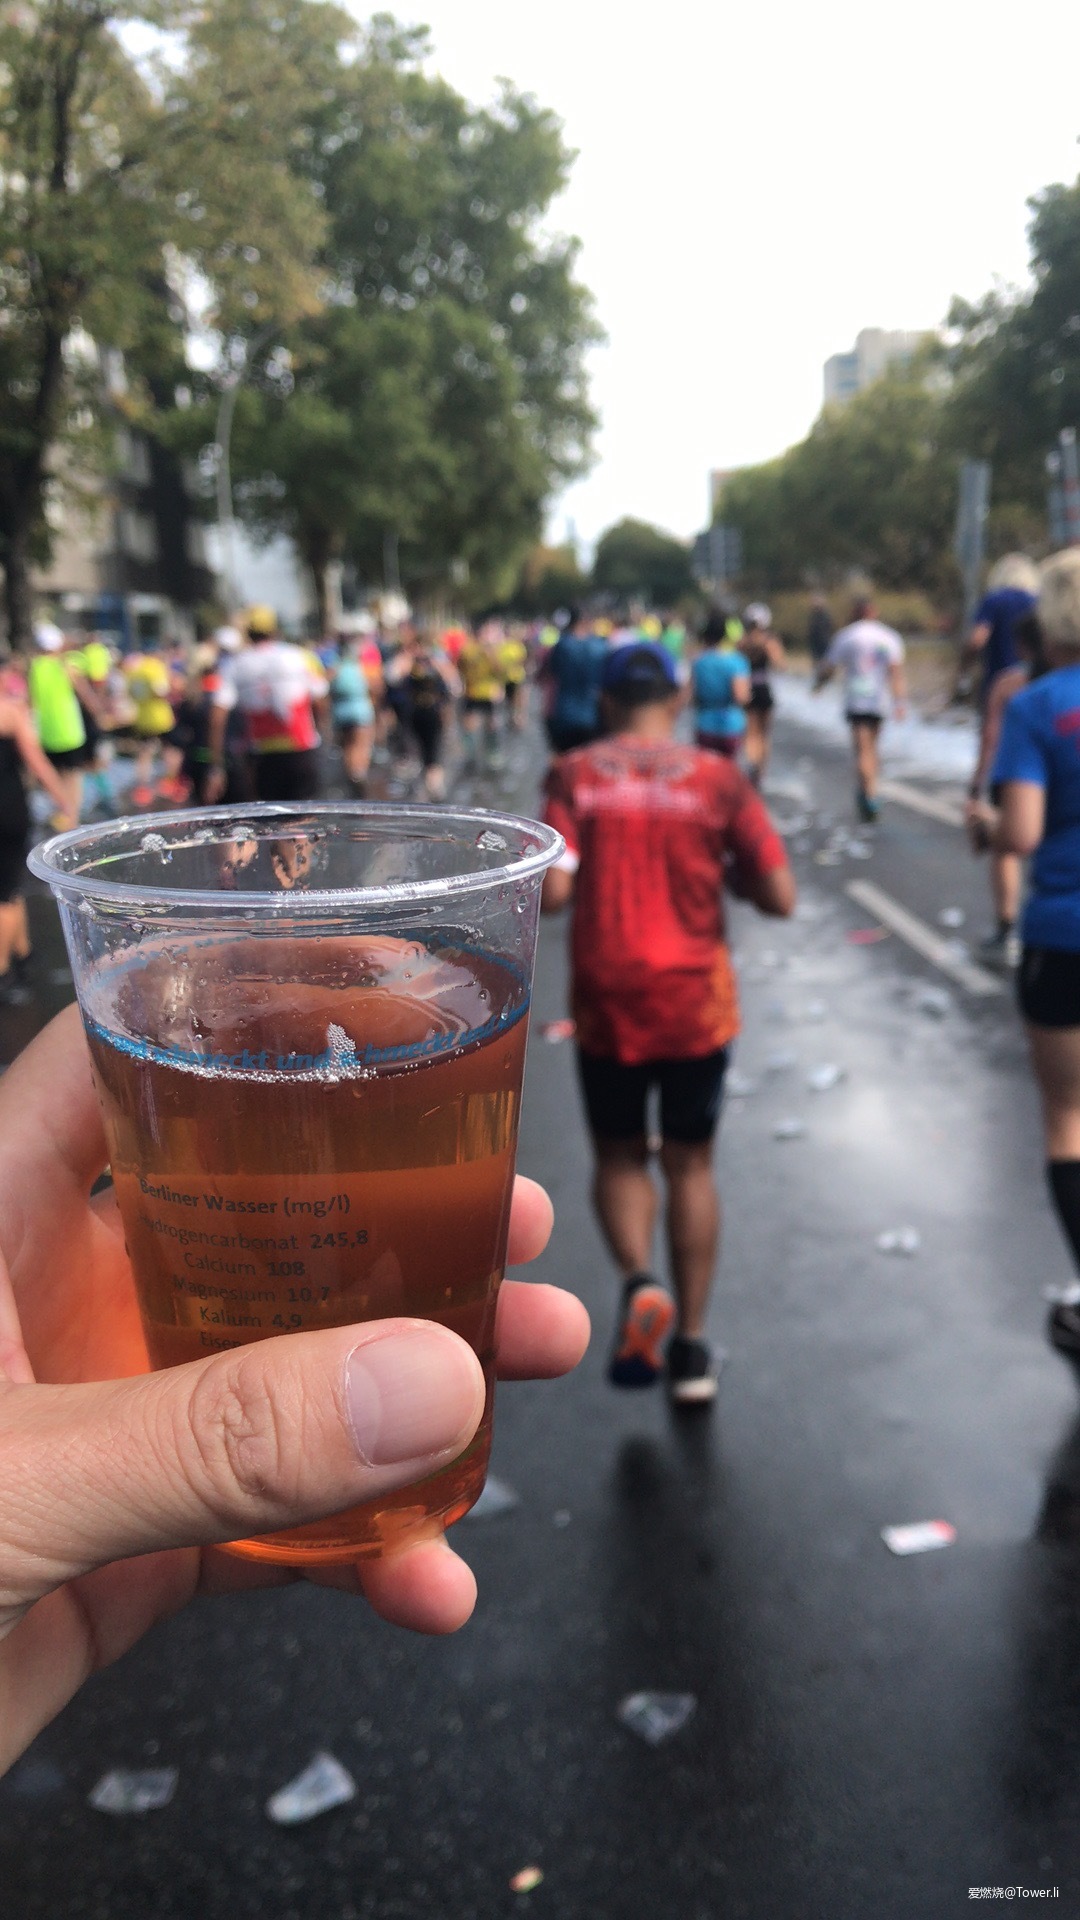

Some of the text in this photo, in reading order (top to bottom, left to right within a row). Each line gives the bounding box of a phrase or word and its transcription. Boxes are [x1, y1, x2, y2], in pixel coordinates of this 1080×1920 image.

[140, 1178, 350, 1218] Berliner Wasser (mg/l)
[309, 1230, 368, 1249] 245,8
[184, 1253, 307, 1277] Calcium 108
[173, 1274, 330, 1305] Magnesium 10,7
[200, 1306, 303, 1330] Kalium 4,9
